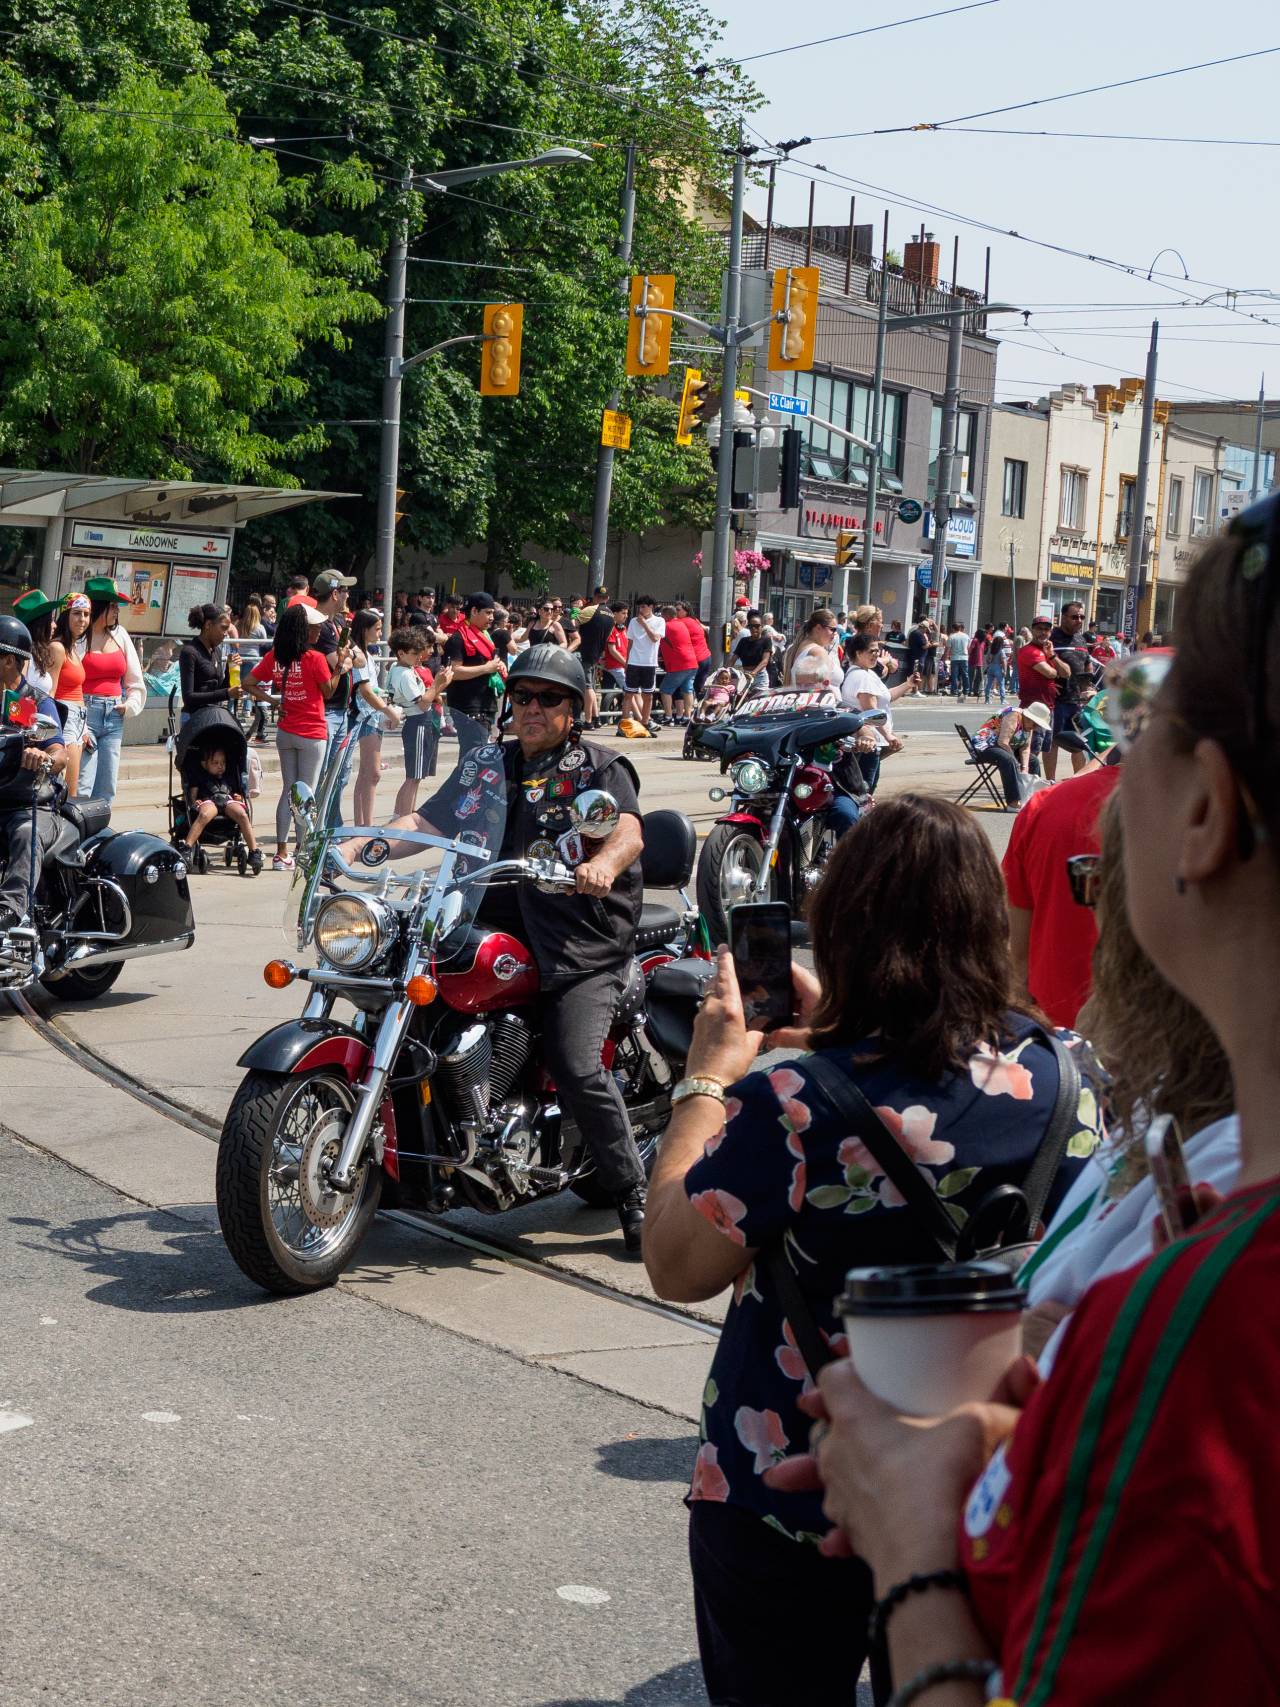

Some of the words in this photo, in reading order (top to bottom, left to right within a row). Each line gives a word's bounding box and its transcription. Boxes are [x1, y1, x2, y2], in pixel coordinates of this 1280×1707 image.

[780, 397, 794, 409] Clair
[948, 519, 975, 534] CLOUD
[129, 534, 179, 550] LANSDOWNE
